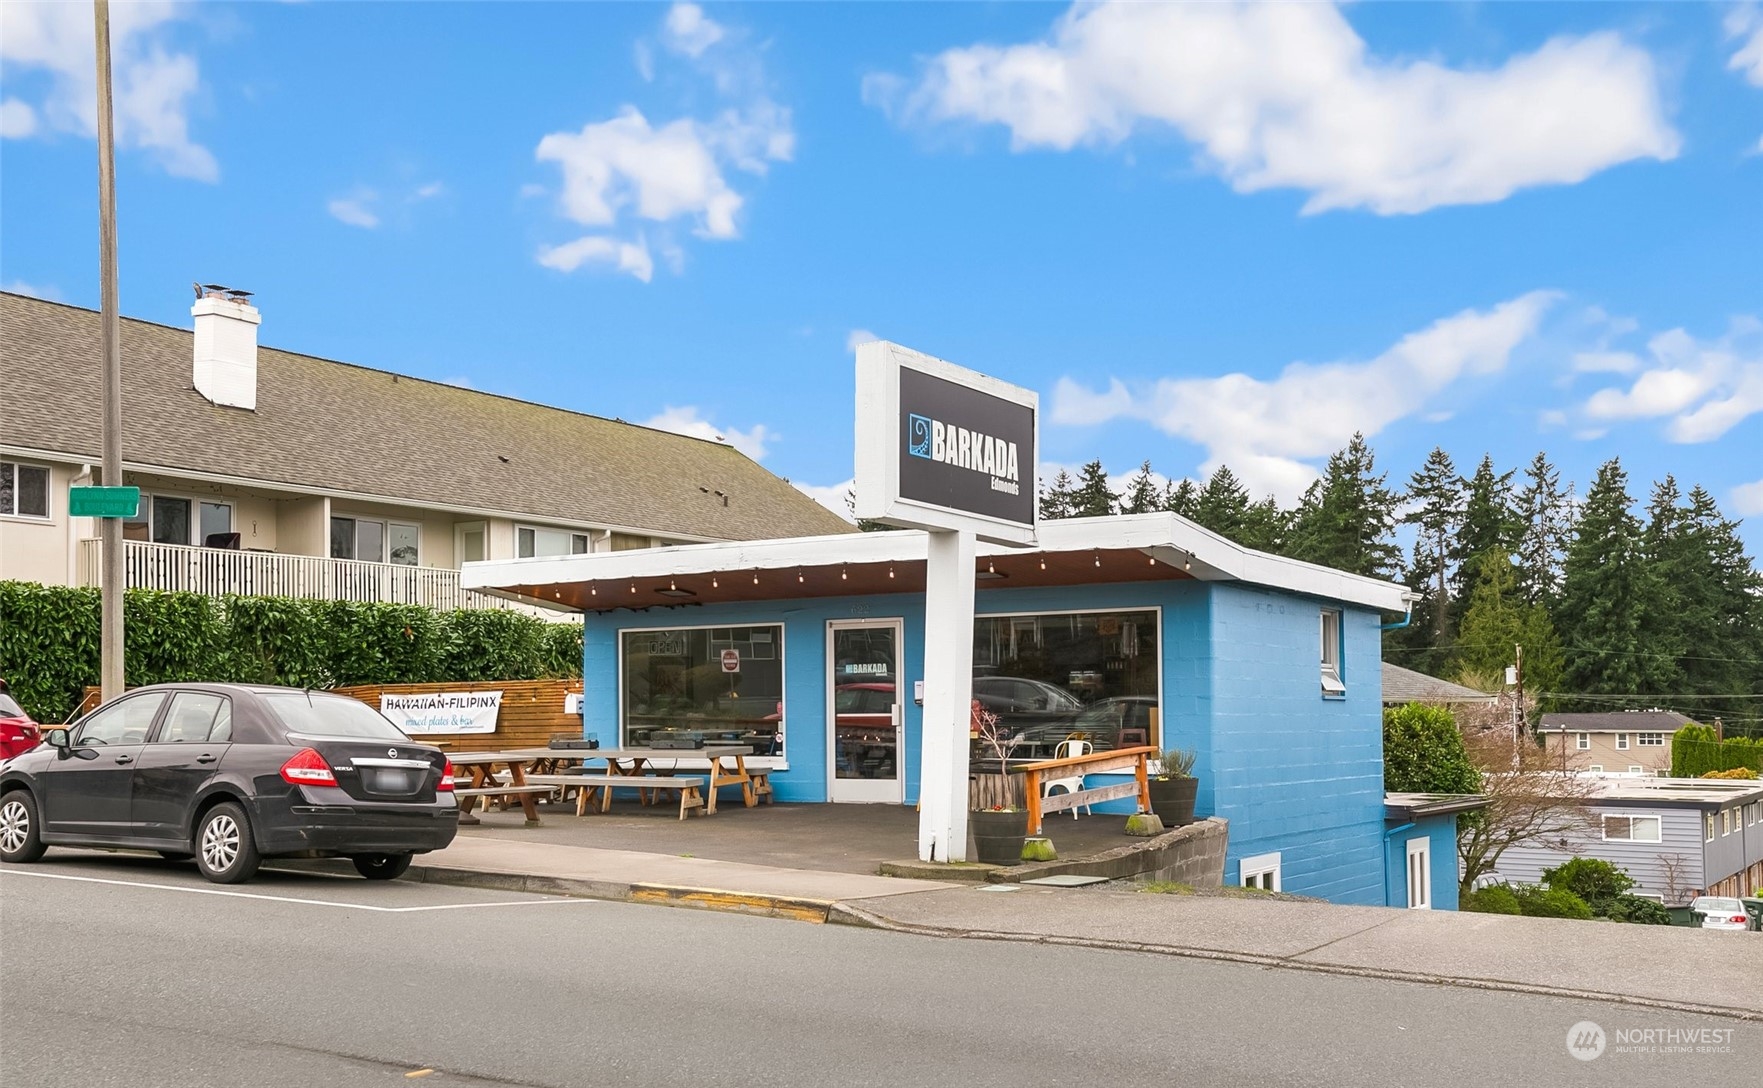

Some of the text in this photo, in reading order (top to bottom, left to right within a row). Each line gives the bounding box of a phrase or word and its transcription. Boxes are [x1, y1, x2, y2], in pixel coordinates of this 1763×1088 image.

[932, 419, 1019, 482] BARKADA
[991, 475, 1019, 496] Edmonds
[650, 640, 681, 654] OPEN
[853, 663, 887, 673] BARKADA
[386, 696, 497, 710] HAWAIIAN-FILIPINX
[428, 715, 449, 730] plates
[451, 715, 459, 726] &
